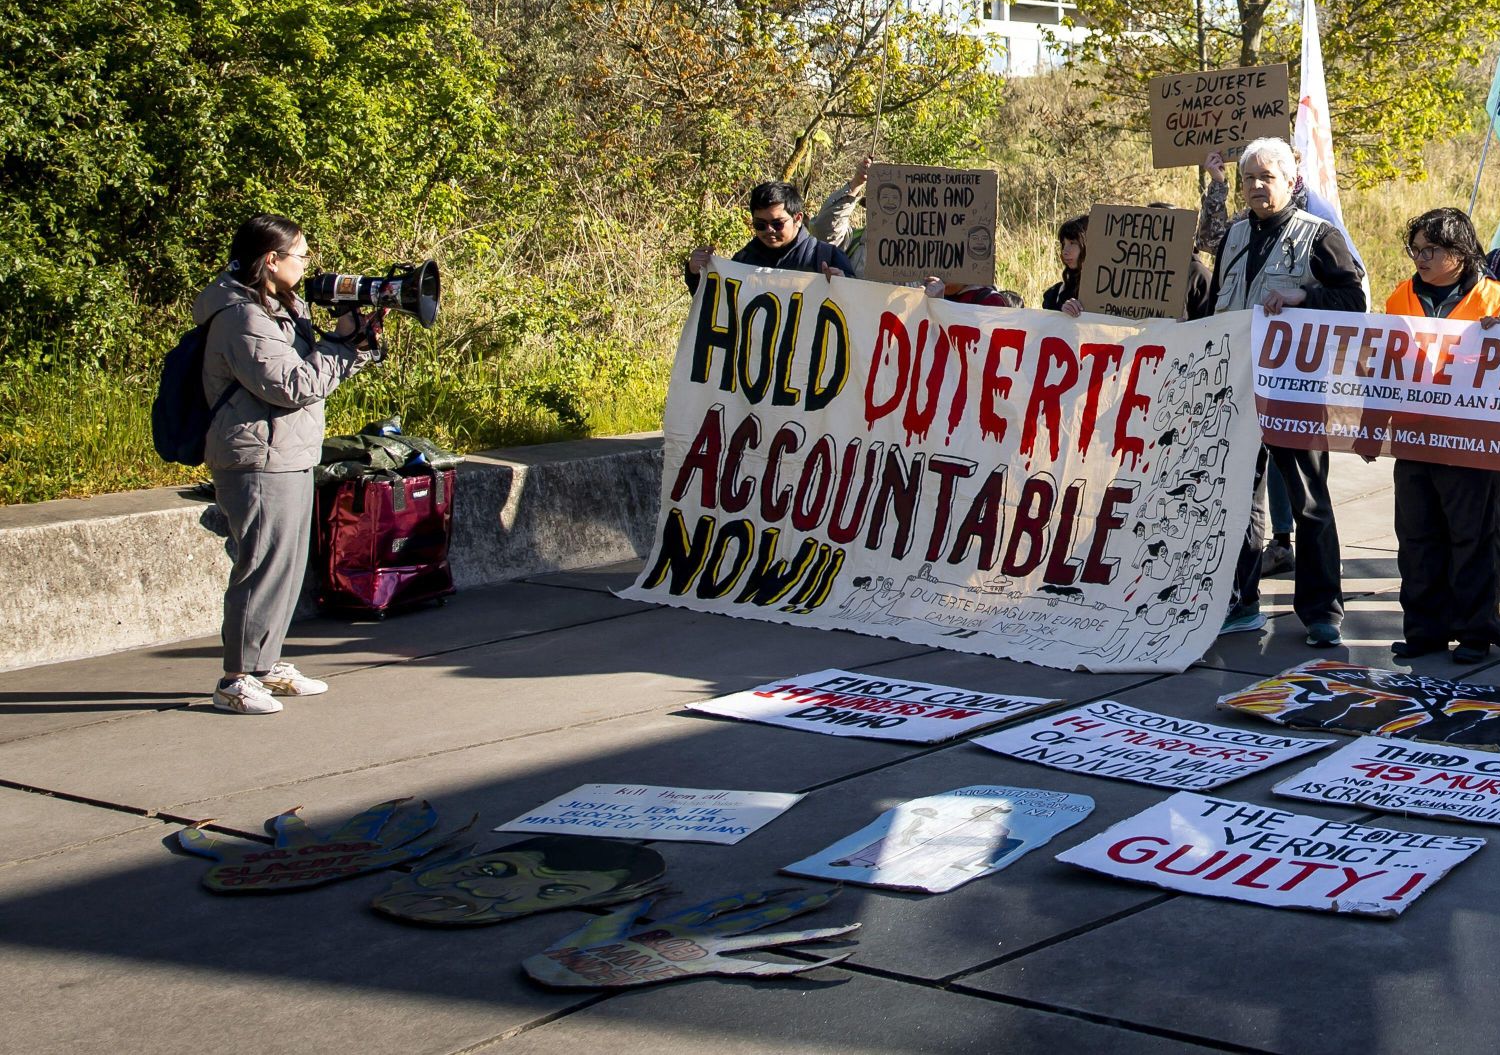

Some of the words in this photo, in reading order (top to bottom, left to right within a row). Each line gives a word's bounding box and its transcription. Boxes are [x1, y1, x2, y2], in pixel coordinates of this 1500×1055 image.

[1166, 111, 1223, 130] GUILTY
[1231, 108, 1247, 121] OF
[1252, 100, 1284, 119] WAR
[1174, 121, 1247, 147] CRIMES!
[908, 187, 938, 208] KING
[944, 187, 974, 208] AND
[896, 211, 947, 237] QUEEN
[951, 213, 966, 226] OF
[1105, 213, 1175, 242] IMPEACH
[879, 238, 965, 269] CORRUPTION
[1111, 240, 1167, 270] SARA
[1096, 265, 1175, 303] DUTERTE
[1258, 320, 1462, 386] DUTERTE
[691, 272, 851, 412] HOLD
[865, 311, 1166, 472] DUTERTE
[1257, 374, 1329, 394] DUTERTE
[1331, 382, 1404, 403] SCHANDE,
[1406, 389, 1452, 405] BLOED
[1454, 393, 1487, 409] AAN
[1258, 413, 1326, 435] HUSTISYA
[1330, 423, 1369, 440] PARA
[1373, 427, 1391, 441] SA
[1394, 429, 1427, 446] MGA
[1429, 433, 1485, 450] BIKTIMA
[671, 402, 1140, 585] ACCOUNTABLE
[641, 507, 846, 614] NOW!!
[910, 587, 970, 611] DUTERTE
[976, 603, 1050, 623] PANAGUTIN
[1054, 615, 1108, 632] EUROPE
[753, 684, 815, 704] 19
[806, 693, 935, 716] MURDERS
[925, 708, 983, 720] IN
[820, 676, 931, 699] FIRST
[938, 691, 1043, 712] COUNT
[785, 706, 908, 730] DAVAO
[1087, 700, 1210, 735] SECOND
[1212, 731, 1321, 750] COUNT
[1030, 730, 1090, 745] OF
[1088, 744, 1165, 764] HIGH
[1169, 757, 1253, 776] VALUE
[1052, 715, 1105, 734] 14
[1102, 728, 1275, 763] MURDERS
[1012, 745, 1225, 788] INDIVIDUALS
[1373, 743, 1470, 768] THIRD
[1351, 762, 1422, 782] 45
[658, 790, 696, 800] them
[1297, 781, 1328, 794] AS
[1326, 784, 1409, 808] CRIMES
[1408, 799, 1468, 812] AGAINST
[1330, 776, 1374, 788] AND
[1376, 783, 1487, 803] ATTEMPTED
[558, 800, 636, 812] JUSTICE
[643, 805, 680, 814] FOR
[689, 807, 736, 815] THE
[559, 810, 640, 821] BLOODY
[645, 815, 737, 824] SUNDAY
[1024, 808, 1056, 818] NA
[518, 816, 611, 828] MASSACRE
[665, 824, 750, 835] CIVILIANS
[1200, 799, 1296, 831] THE
[1310, 820, 1486, 851] PEOPLE'S
